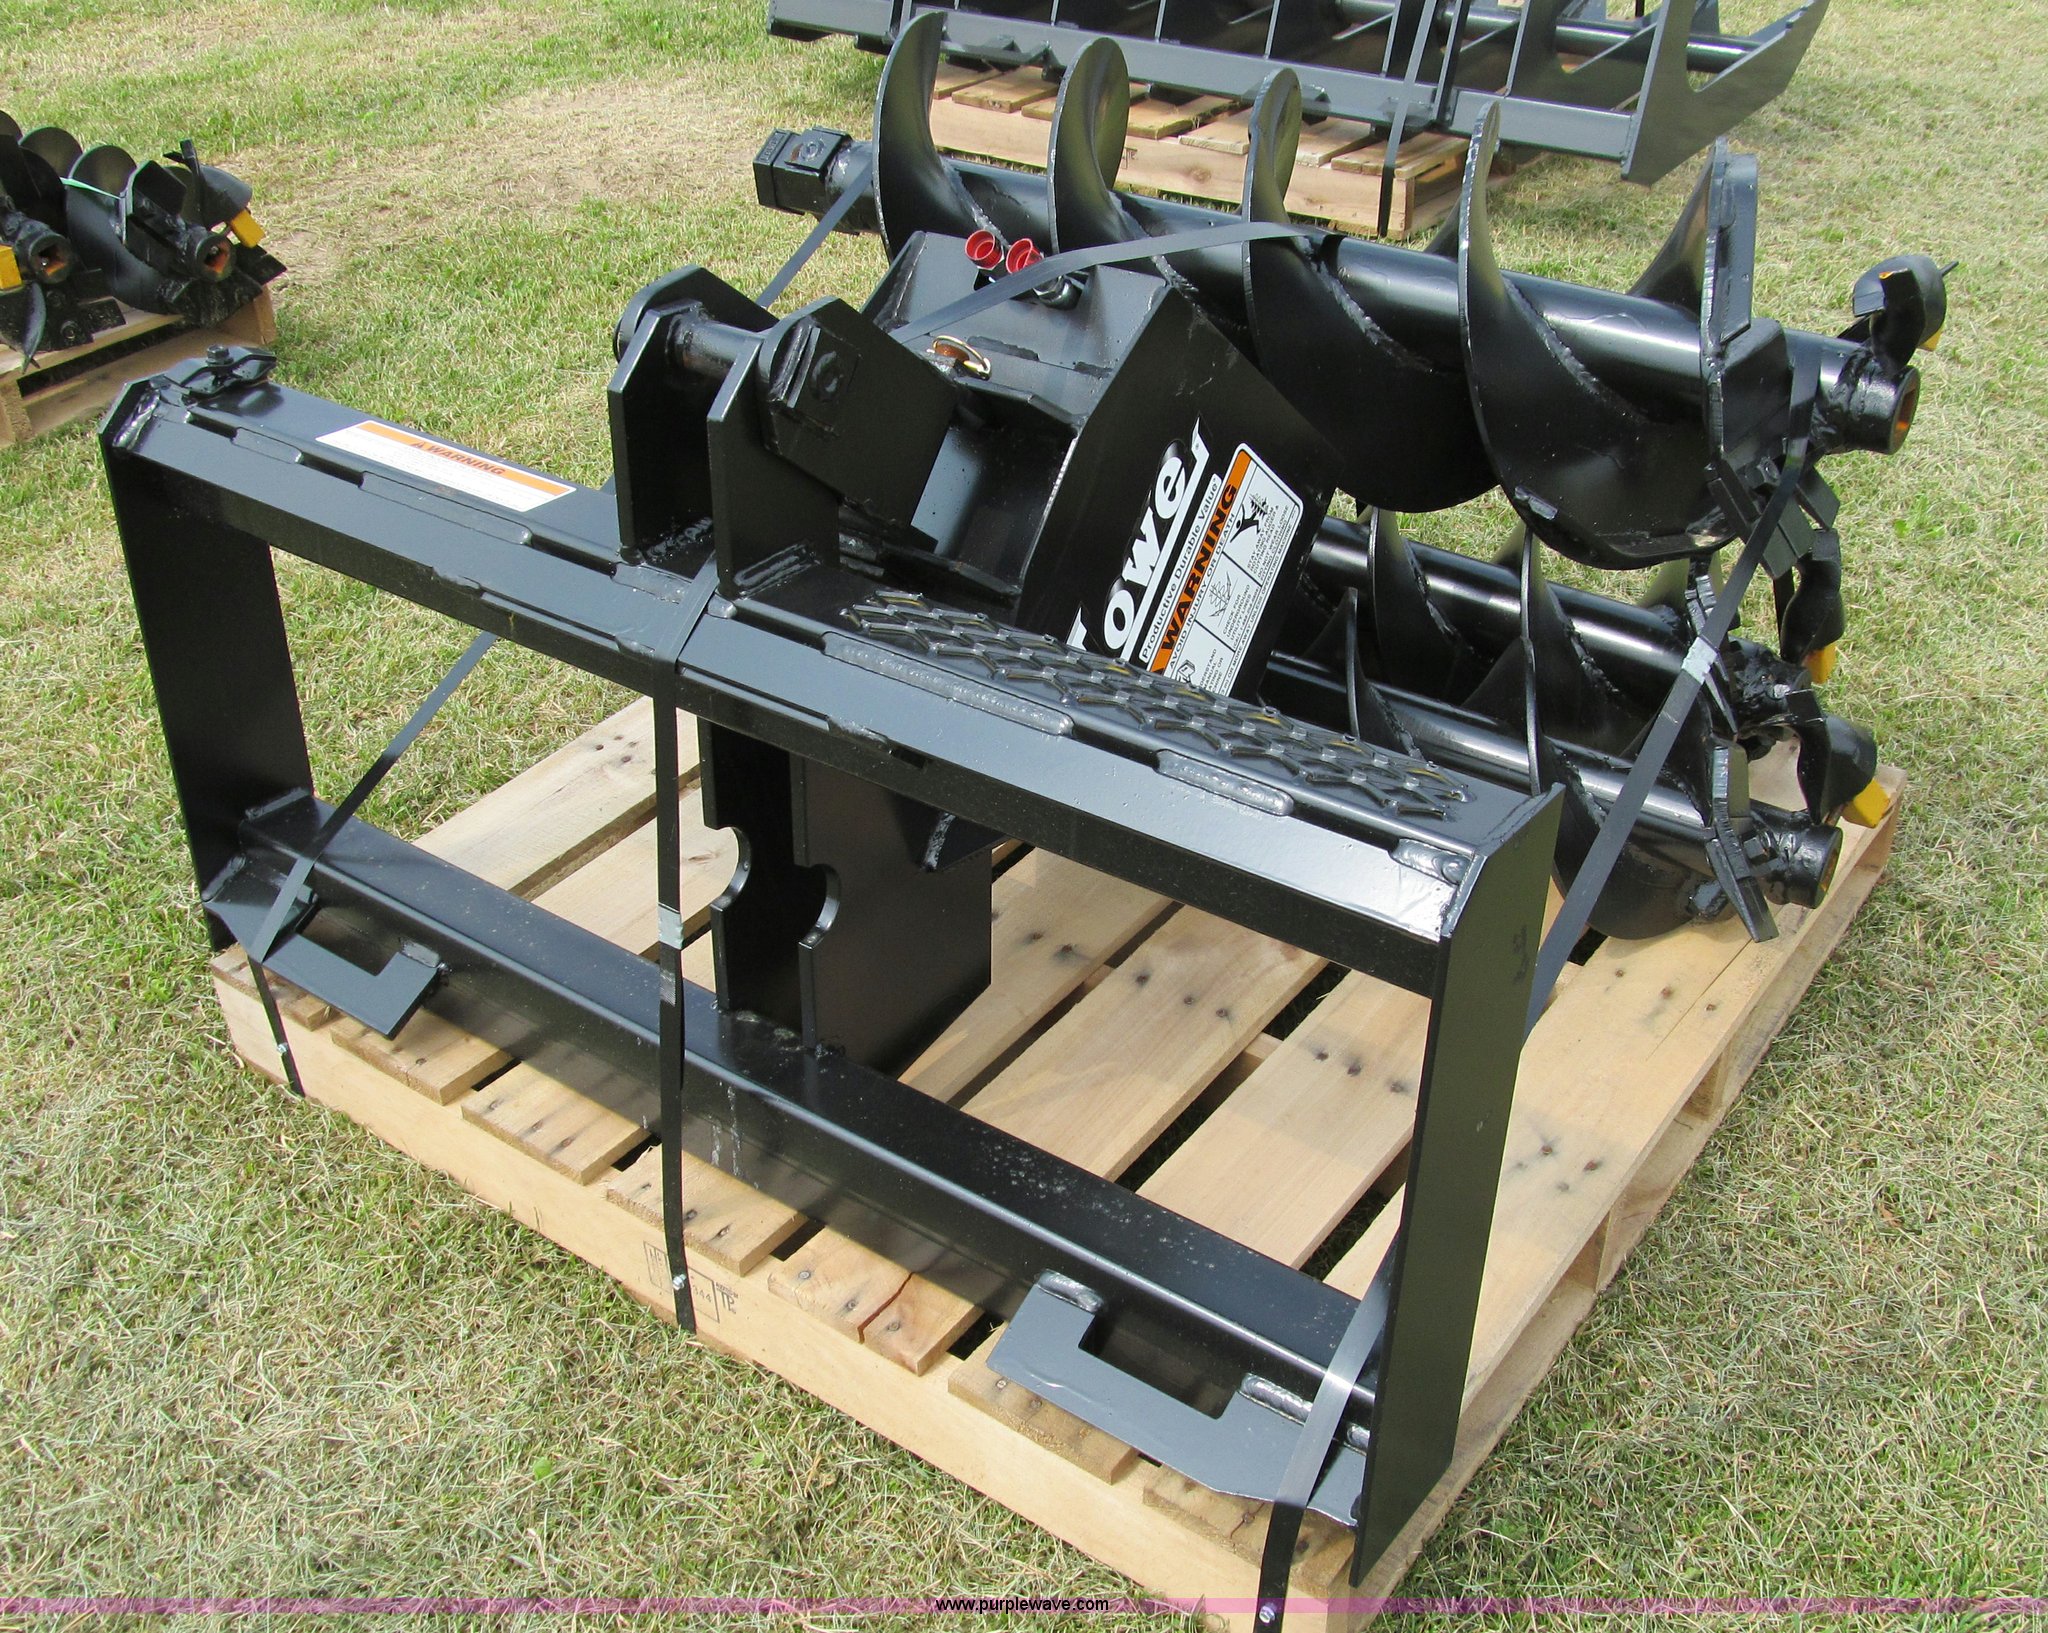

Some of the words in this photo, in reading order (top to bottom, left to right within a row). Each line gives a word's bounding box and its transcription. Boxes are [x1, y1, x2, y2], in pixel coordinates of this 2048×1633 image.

[428, 444, 506, 475] WARNING
[1141, 581, 1176, 659] Productive
[1174, 523, 1200, 579] Durable
[1161, 482, 1237, 654] WARNING
[1169, 629, 1187, 668] AVOID
[1186, 580, 1207, 626] INJURY
[1206, 557, 1216, 577] OR
[1215, 513, 1234, 554] DEATH
[1222, 610, 1234, 634] CHECK
[1232, 593, 1240, 609] FOR
[1199, 648, 1216, 686] DERSTAND
